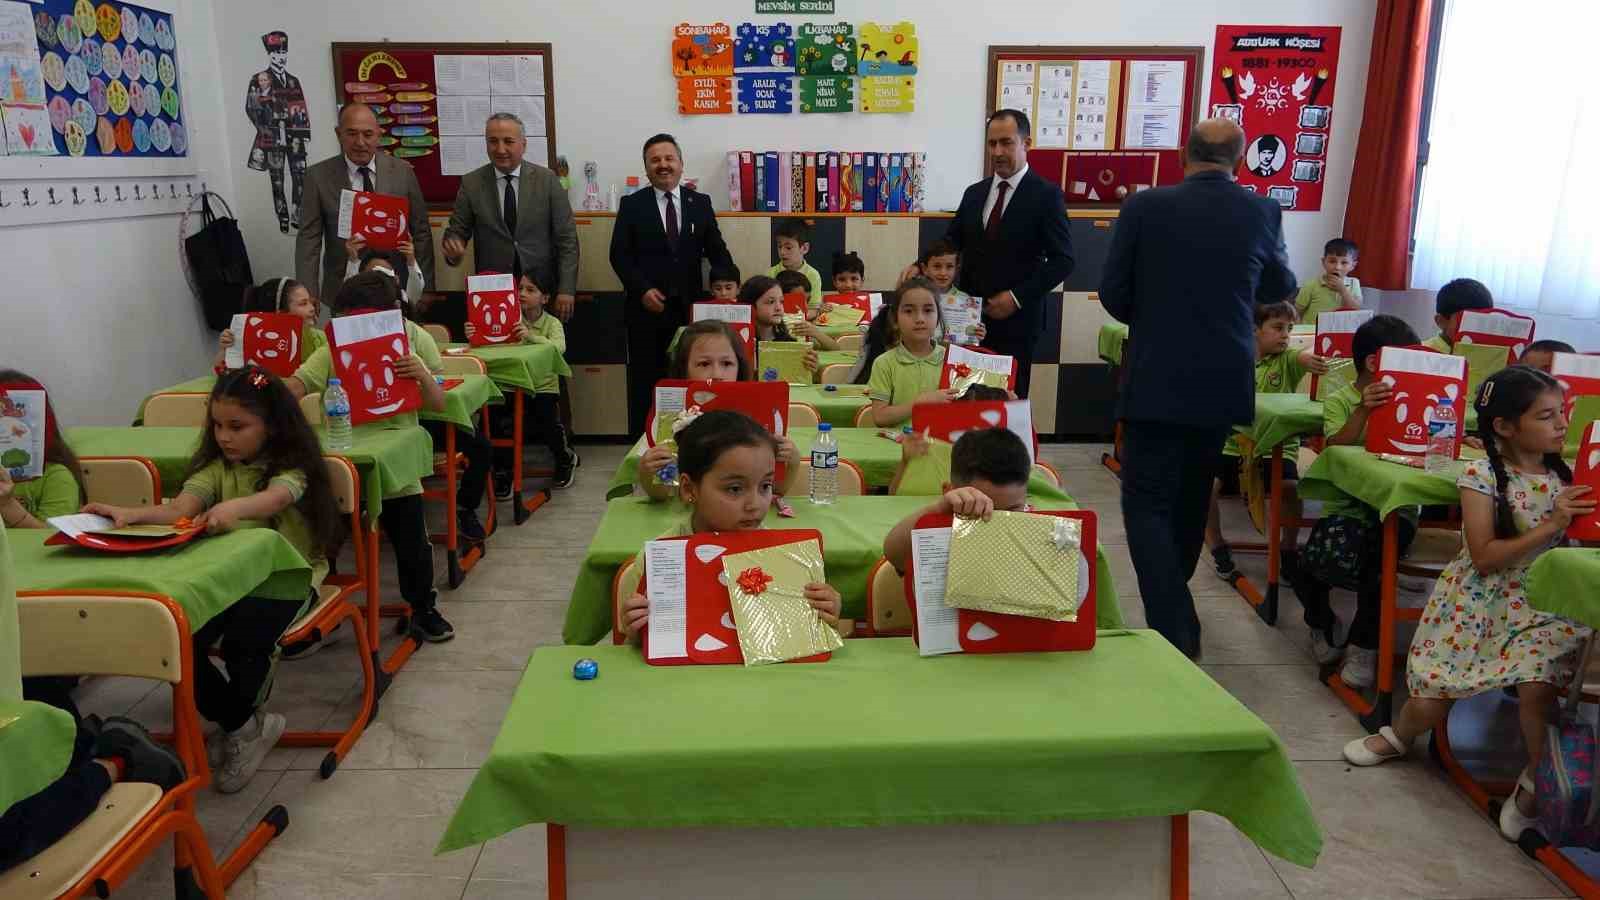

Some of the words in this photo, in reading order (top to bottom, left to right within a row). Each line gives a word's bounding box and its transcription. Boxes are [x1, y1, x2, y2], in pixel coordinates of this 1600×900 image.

[678, 26, 727, 35] SONBAHAR
[756, 26, 770, 37] KIŞ
[1285, 37, 1321, 49] KÖŞESİ
[752, 79, 777, 88] ARALIK
[816, 79, 835, 87] MART
[756, 90, 774, 98] OCAK
